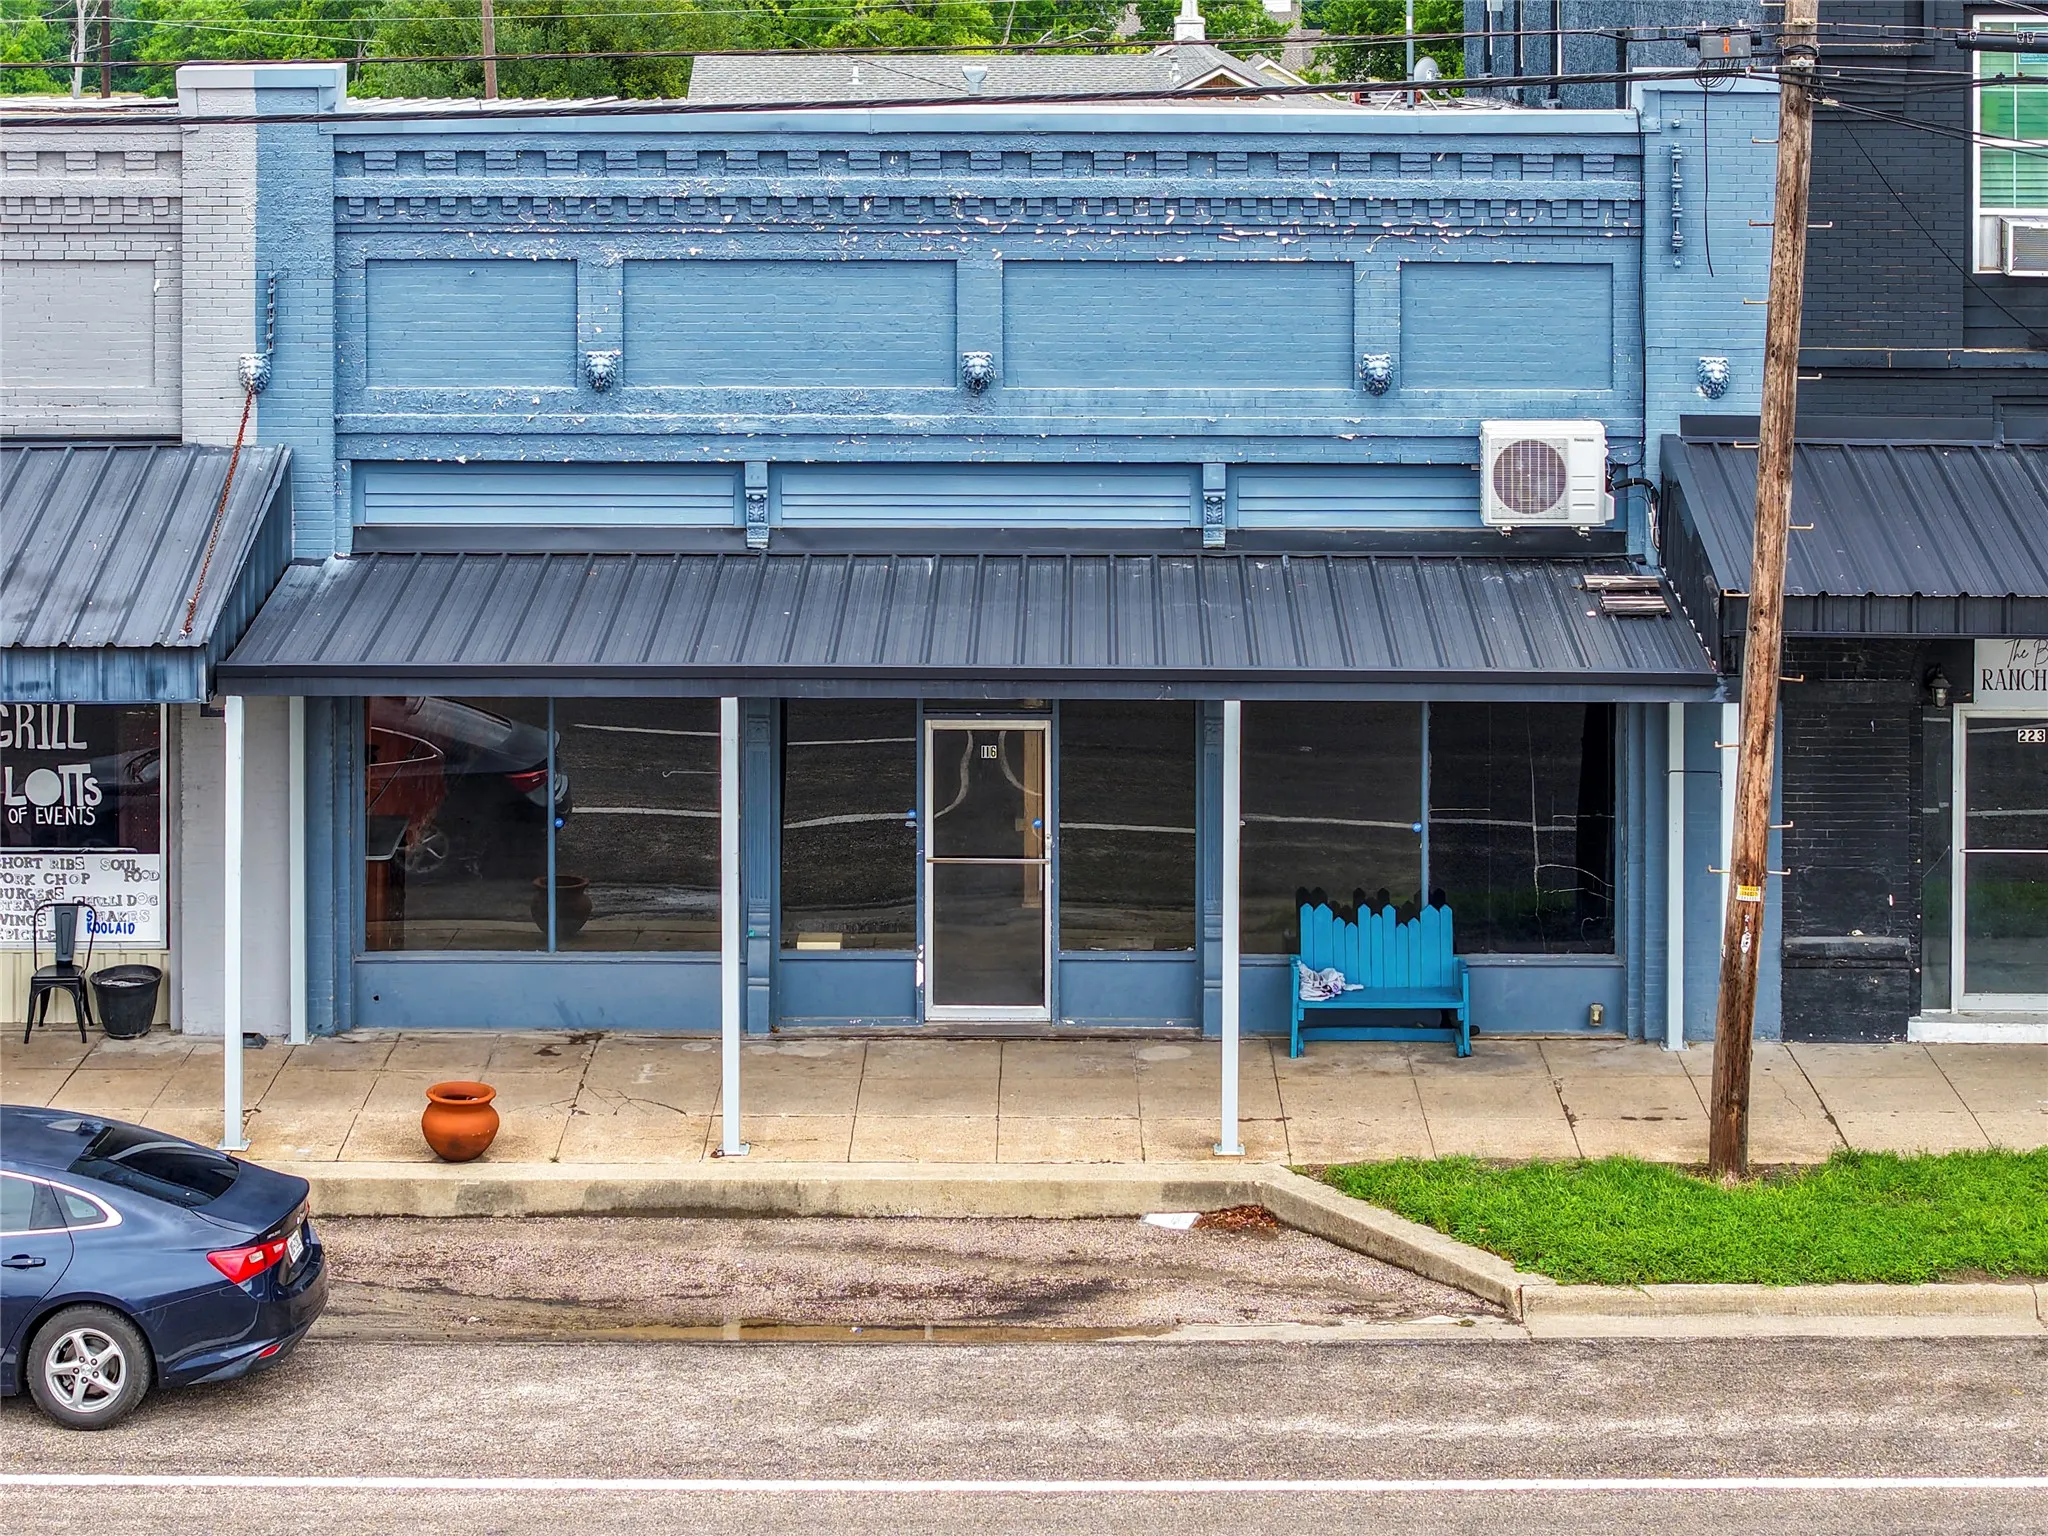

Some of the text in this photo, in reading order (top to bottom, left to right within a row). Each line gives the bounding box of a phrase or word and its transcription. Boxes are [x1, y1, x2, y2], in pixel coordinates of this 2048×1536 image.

[2004, 640, 2029, 668] The
[1981, 669, 2047, 691] RANCH
[2019, 730, 2045, 742] 223
[982, 746, 996, 758] 116
[8, 807, 96, 825] OF EVENTS
[0, 857, 85, 870] HORT RIBS
[43, 873, 90, 885] CHOP
[123, 870, 160, 883] FOOD
[126, 892, 158, 906] DOG
[86, 922, 135, 934] KOOLAID
